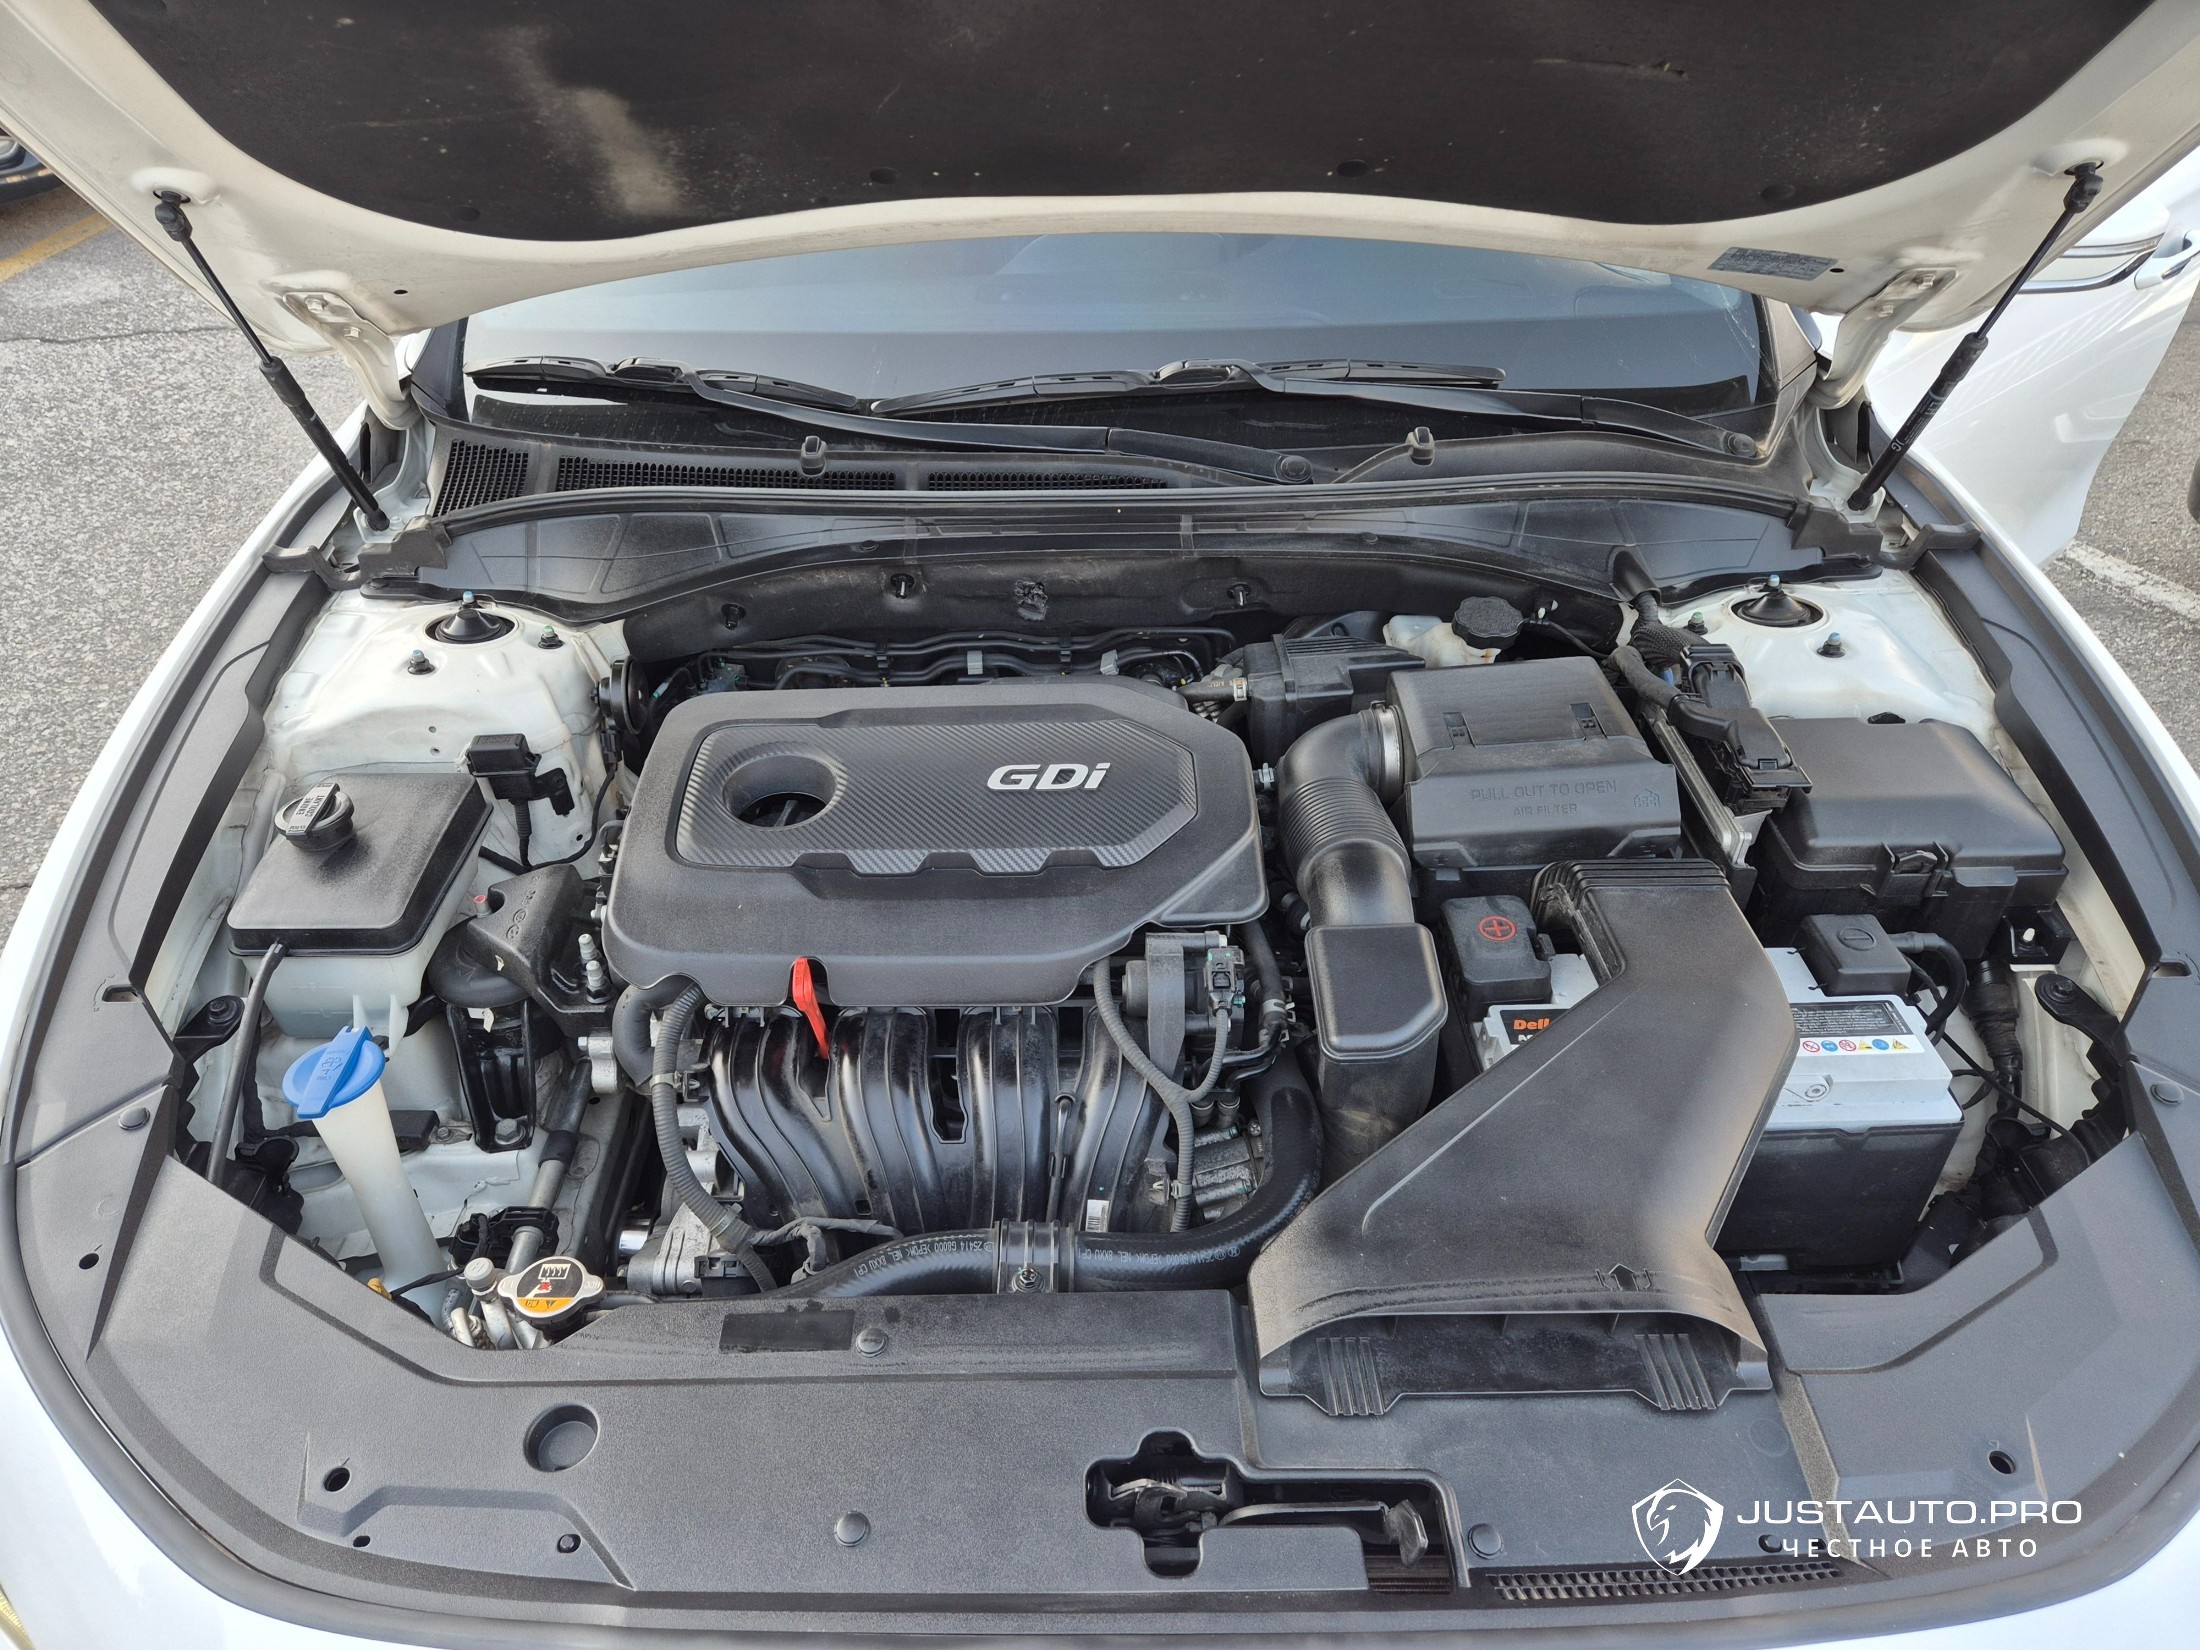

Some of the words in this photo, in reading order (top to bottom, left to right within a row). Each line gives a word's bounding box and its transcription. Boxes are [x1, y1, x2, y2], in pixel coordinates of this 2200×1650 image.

[986, 761, 1112, 791] GDi
[1470, 787, 1510, 801] PULL
[1514, 783, 1545, 799] OUT
[1549, 783, 1571, 797] TO
[1574, 779, 1617, 795] OPEN
[296, 797, 314, 816] ENGINE
[304, 795, 325, 817] COOLANT
[1512, 805, 1534, 817] AIR
[1537, 803, 1578, 815] FILTER
